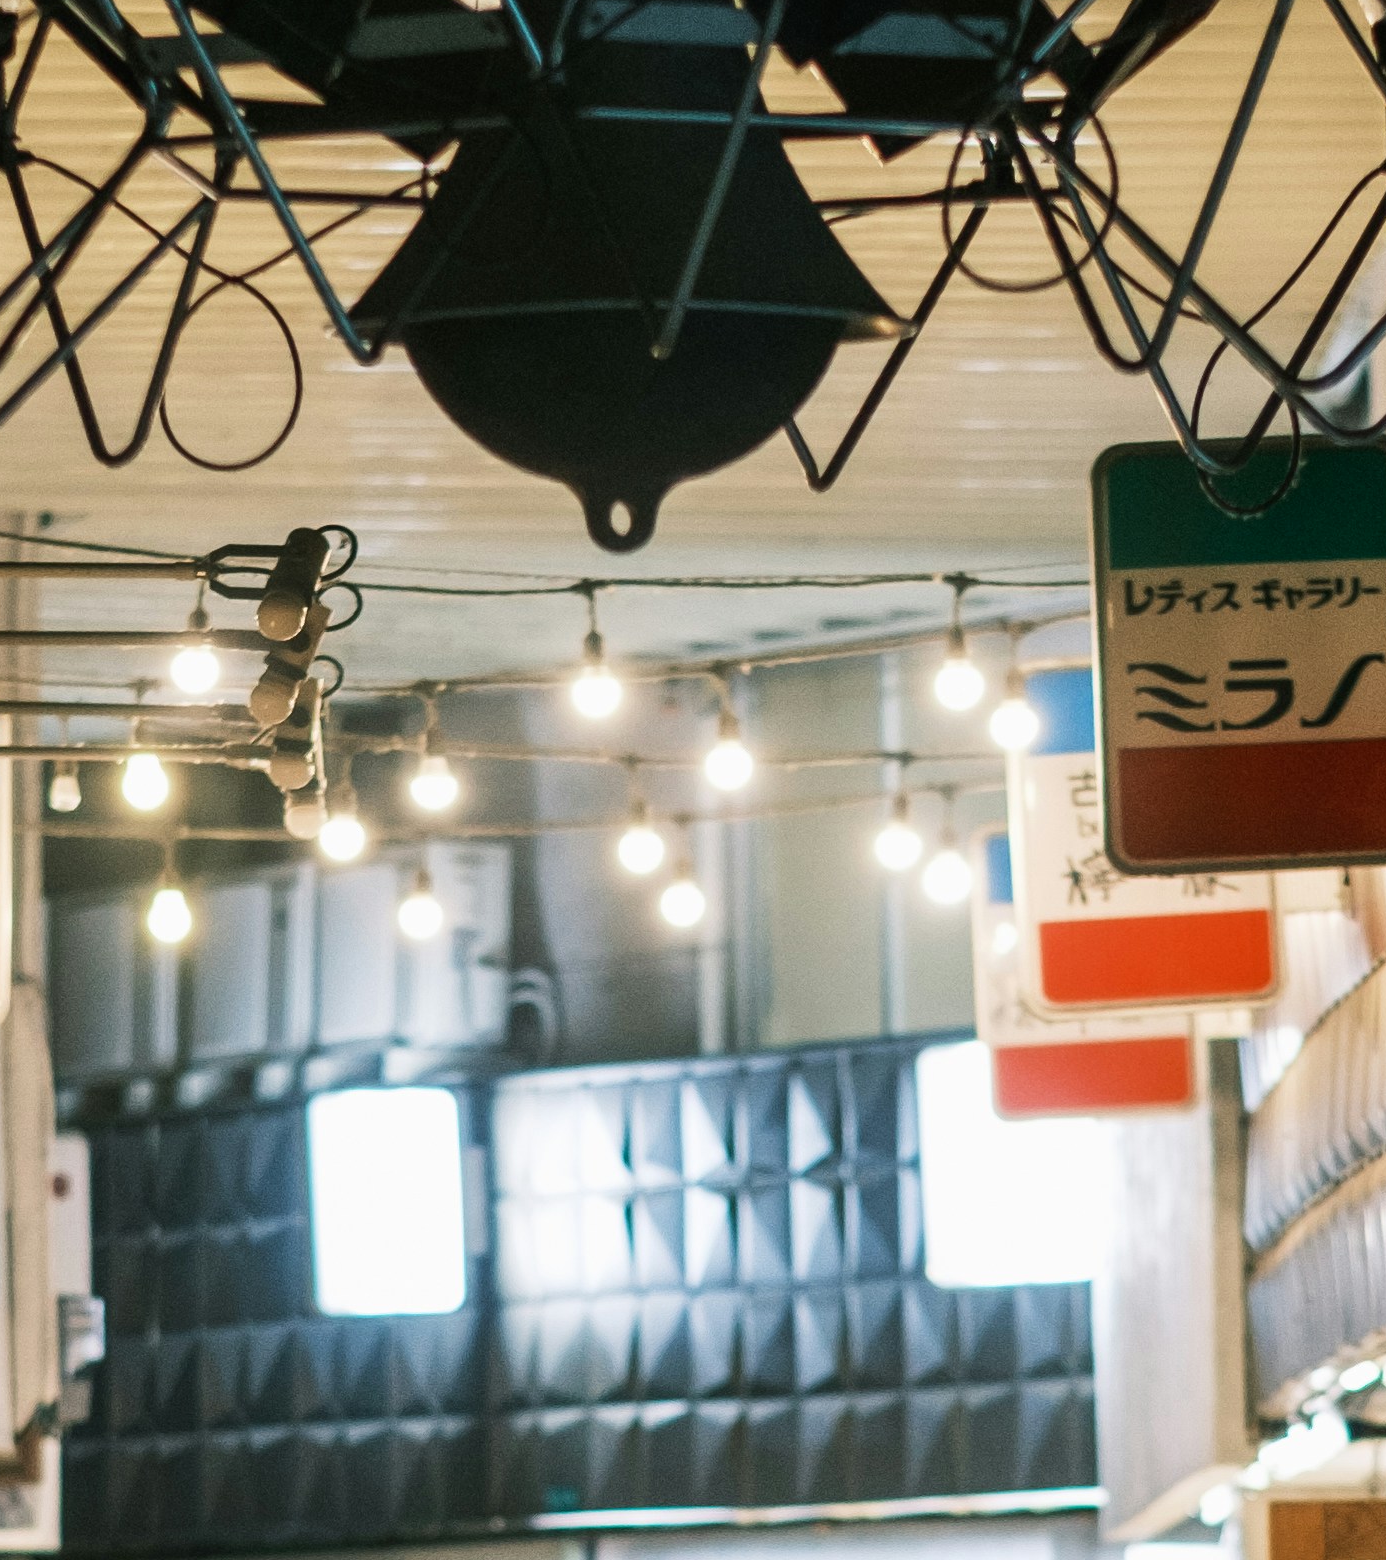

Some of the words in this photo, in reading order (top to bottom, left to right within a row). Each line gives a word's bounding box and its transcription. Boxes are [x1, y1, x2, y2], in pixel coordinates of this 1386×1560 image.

[1124, 578, 1240, 616] レディス
[1252, 576, 1381, 611] ギャラリー
[1126, 652, 1386, 733] ミラノ
